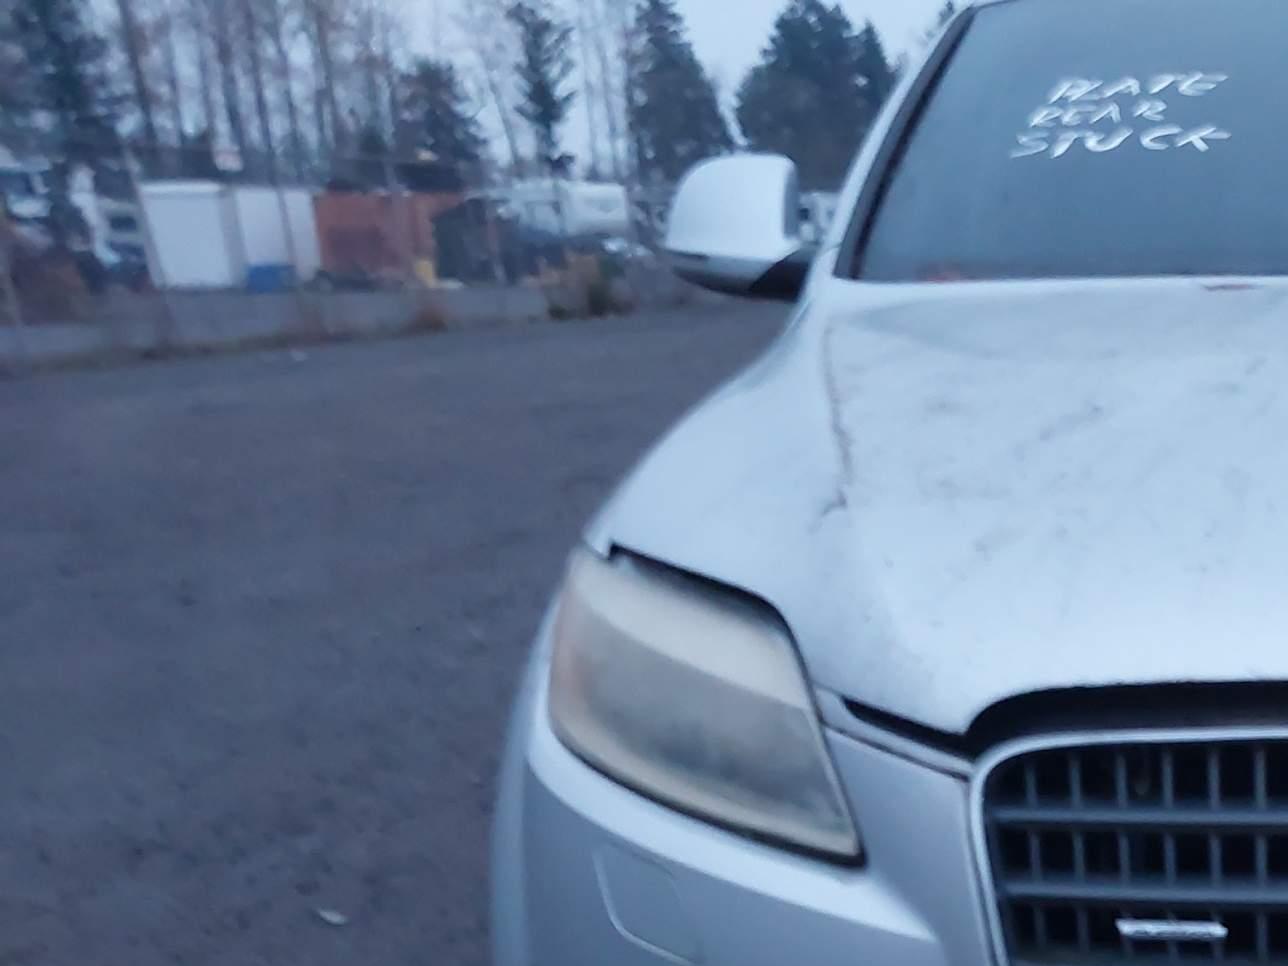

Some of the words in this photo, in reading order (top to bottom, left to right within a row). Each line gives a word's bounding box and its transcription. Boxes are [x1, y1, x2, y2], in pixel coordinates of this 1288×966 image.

[1050, 73, 1229, 104] PLATE
[1028, 100, 1168, 128] REAR
[1009, 127, 1232, 159] STUCK
